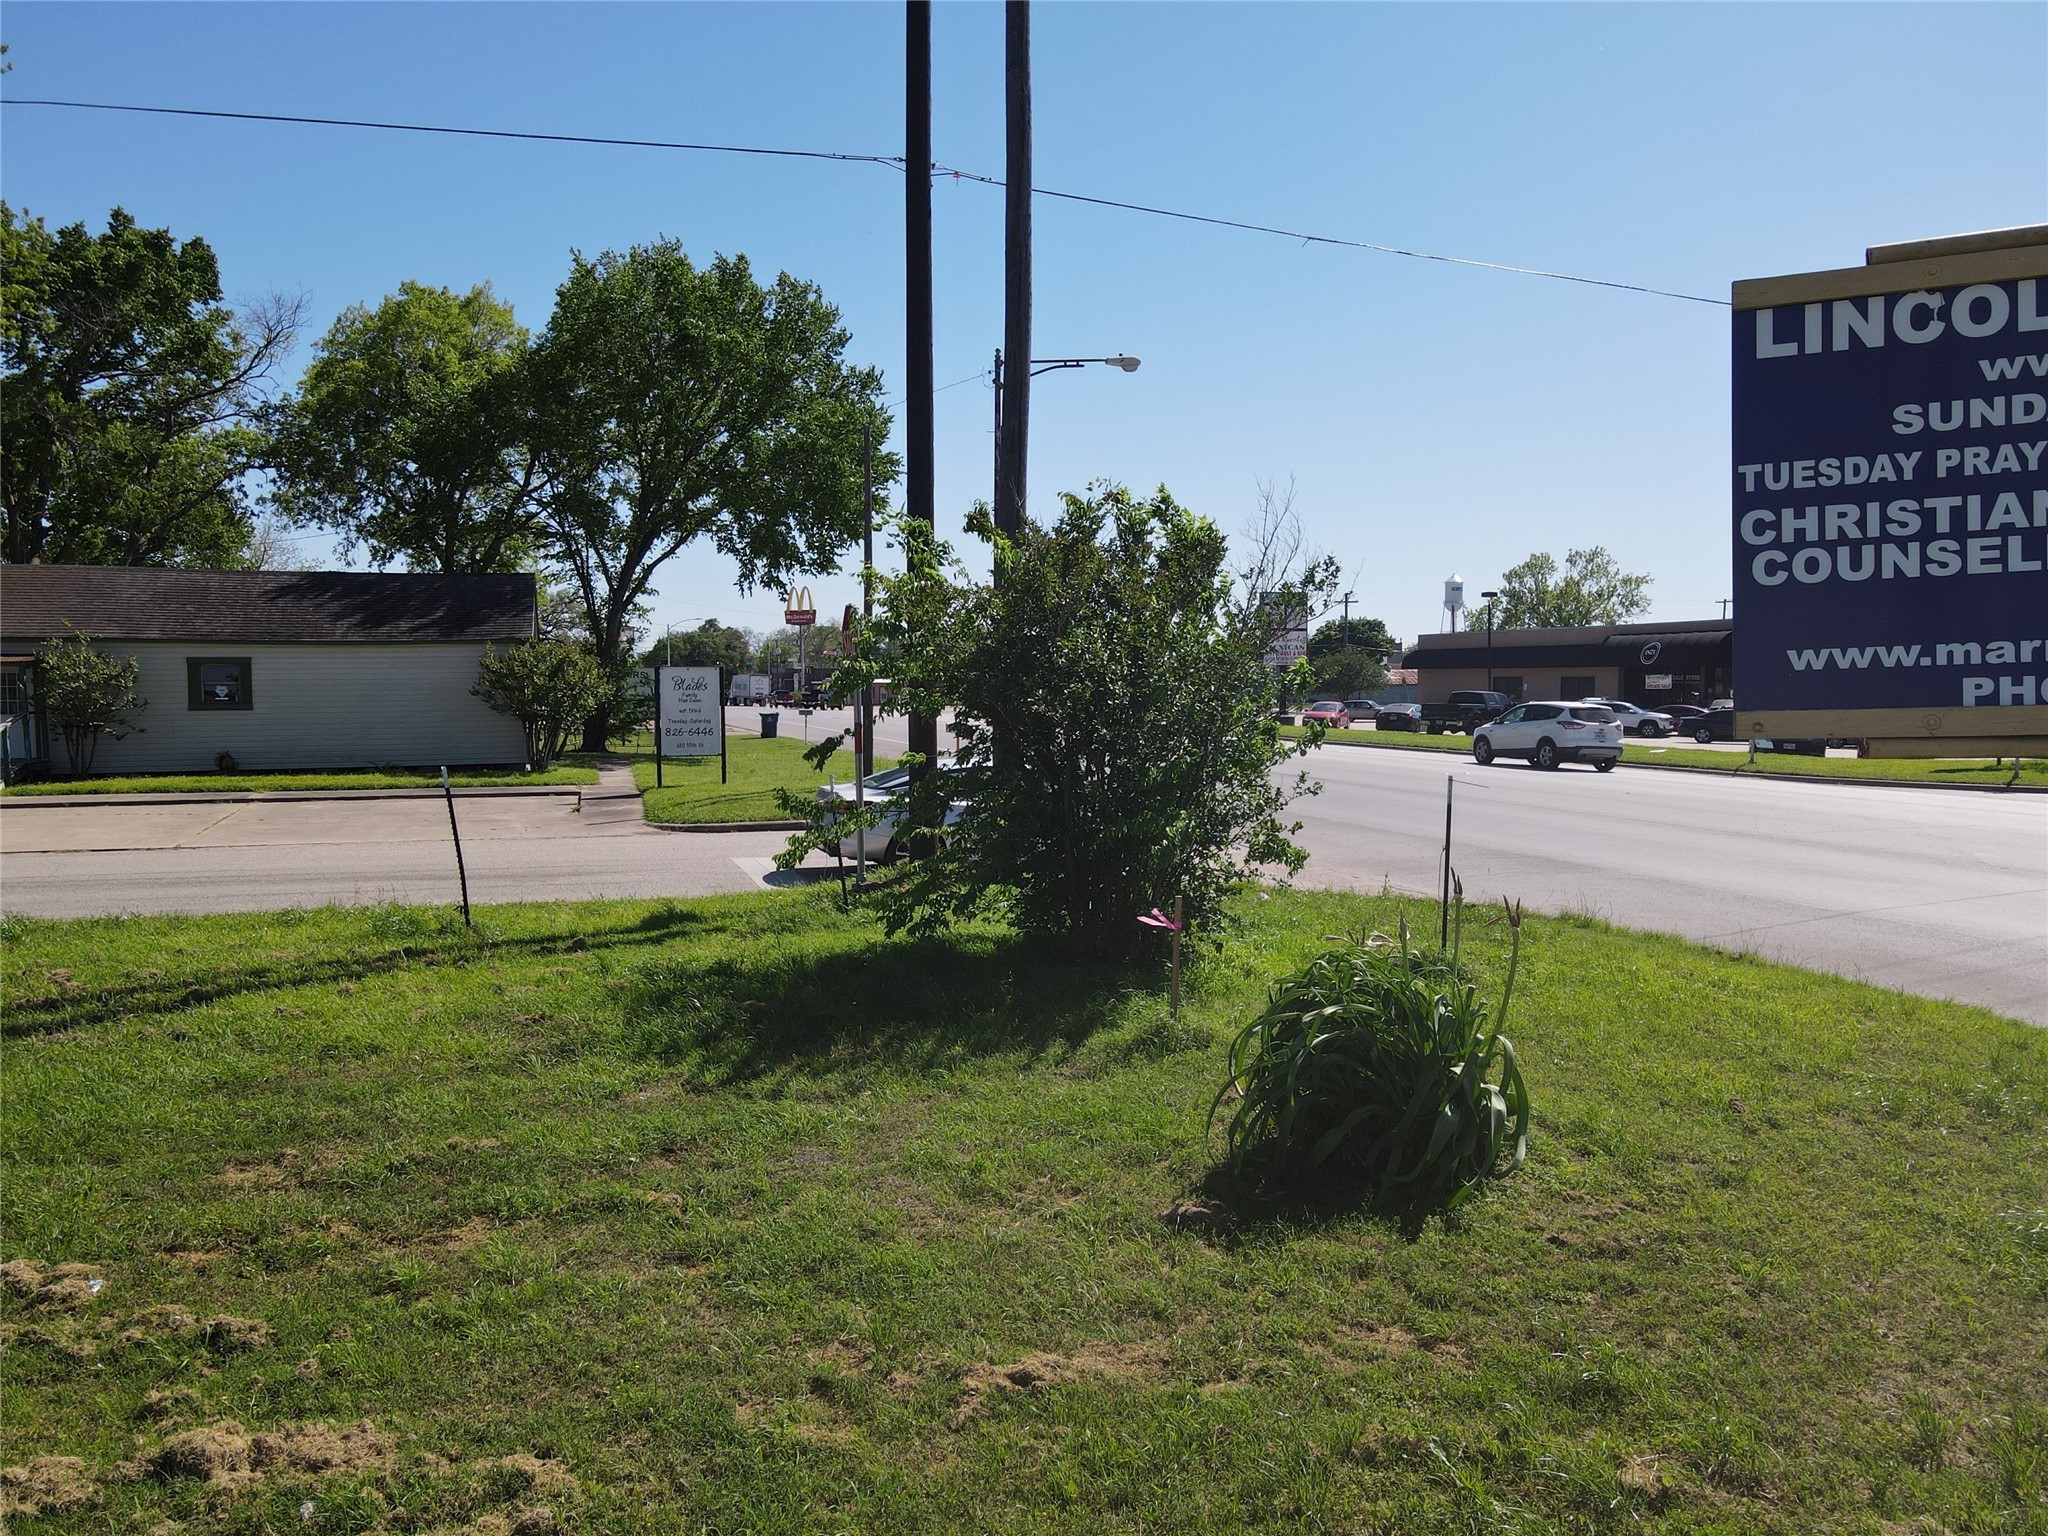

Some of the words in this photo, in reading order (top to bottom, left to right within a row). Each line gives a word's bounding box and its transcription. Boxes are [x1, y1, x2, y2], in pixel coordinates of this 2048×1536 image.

[1756, 279, 2048, 359] LINCOL
[1892, 394, 2048, 435] SUND
[1738, 451, 1923, 492] TUESDAY
[1937, 441, 2048, 478] PRAY
[1752, 534, 2048, 586] COUNSEL
[1787, 639, 2048, 671] www.mar
[671, 675, 708, 691] Blades
[1963, 676, 2048, 707] PH
[665, 727, 714, 736] 826-6446
